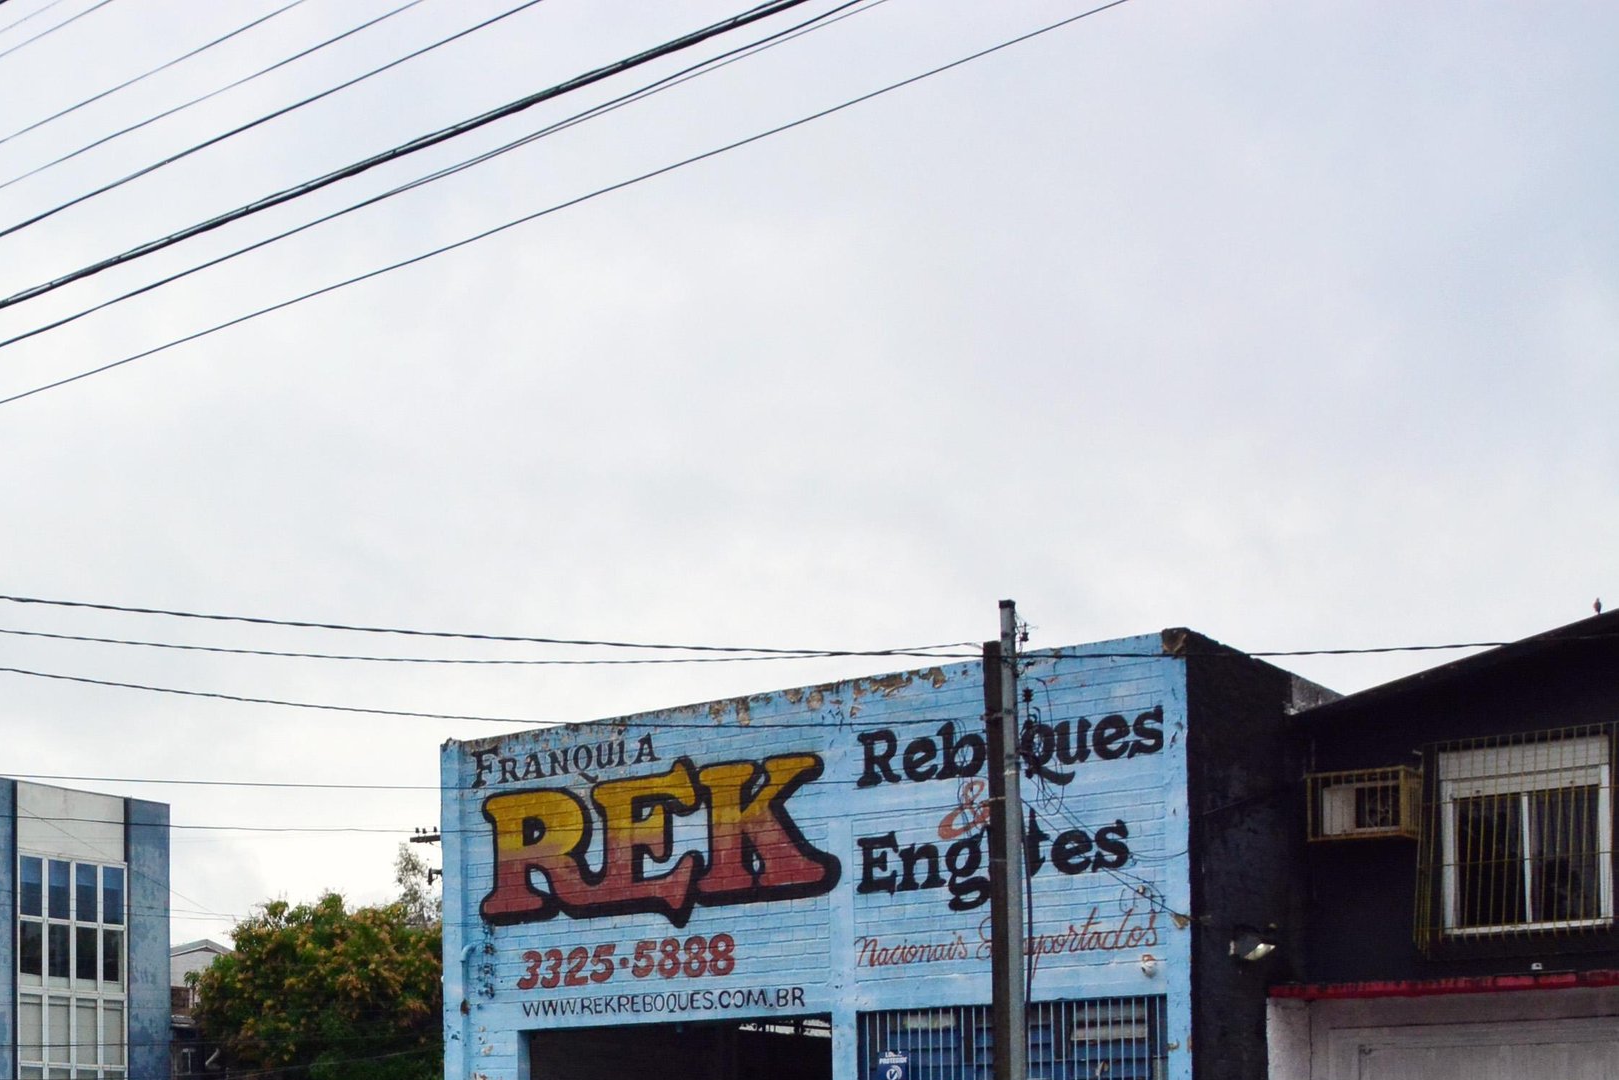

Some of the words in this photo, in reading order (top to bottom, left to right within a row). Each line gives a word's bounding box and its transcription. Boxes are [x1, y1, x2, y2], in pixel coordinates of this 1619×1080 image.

[856, 705, 1164, 786] Rebques
[479, 753, 842, 928] REK
[856, 807, 1131, 911] Engtes
[854, 931, 968, 968] Nacionais
[522, 986, 805, 1018] WWW.REKREBOQUES.COM.BR
